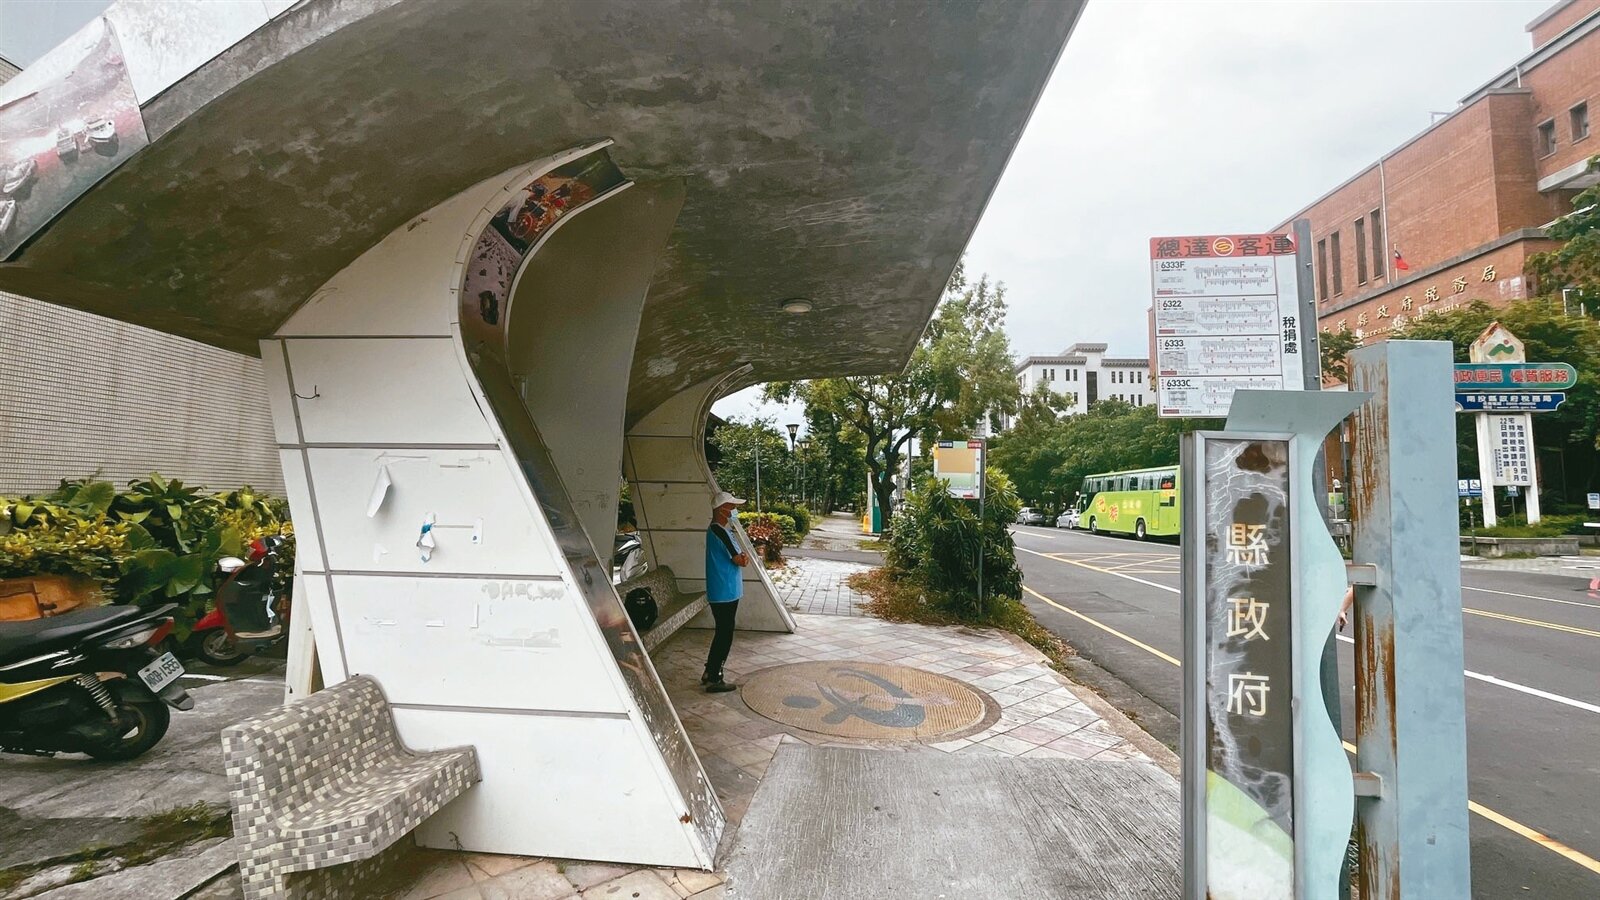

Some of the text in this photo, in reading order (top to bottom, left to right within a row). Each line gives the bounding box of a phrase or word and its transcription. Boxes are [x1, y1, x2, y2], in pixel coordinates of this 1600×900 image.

[1161, 261, 1185, 269] 6333F
[1163, 300, 1182, 308] 6322
[1282, 316, 1298, 354] 稅捐處
[1164, 339, 1184, 347] 6333
[1167, 379, 1191, 387] 6333C
[1225, 523, 1271, 717] 縣政府
